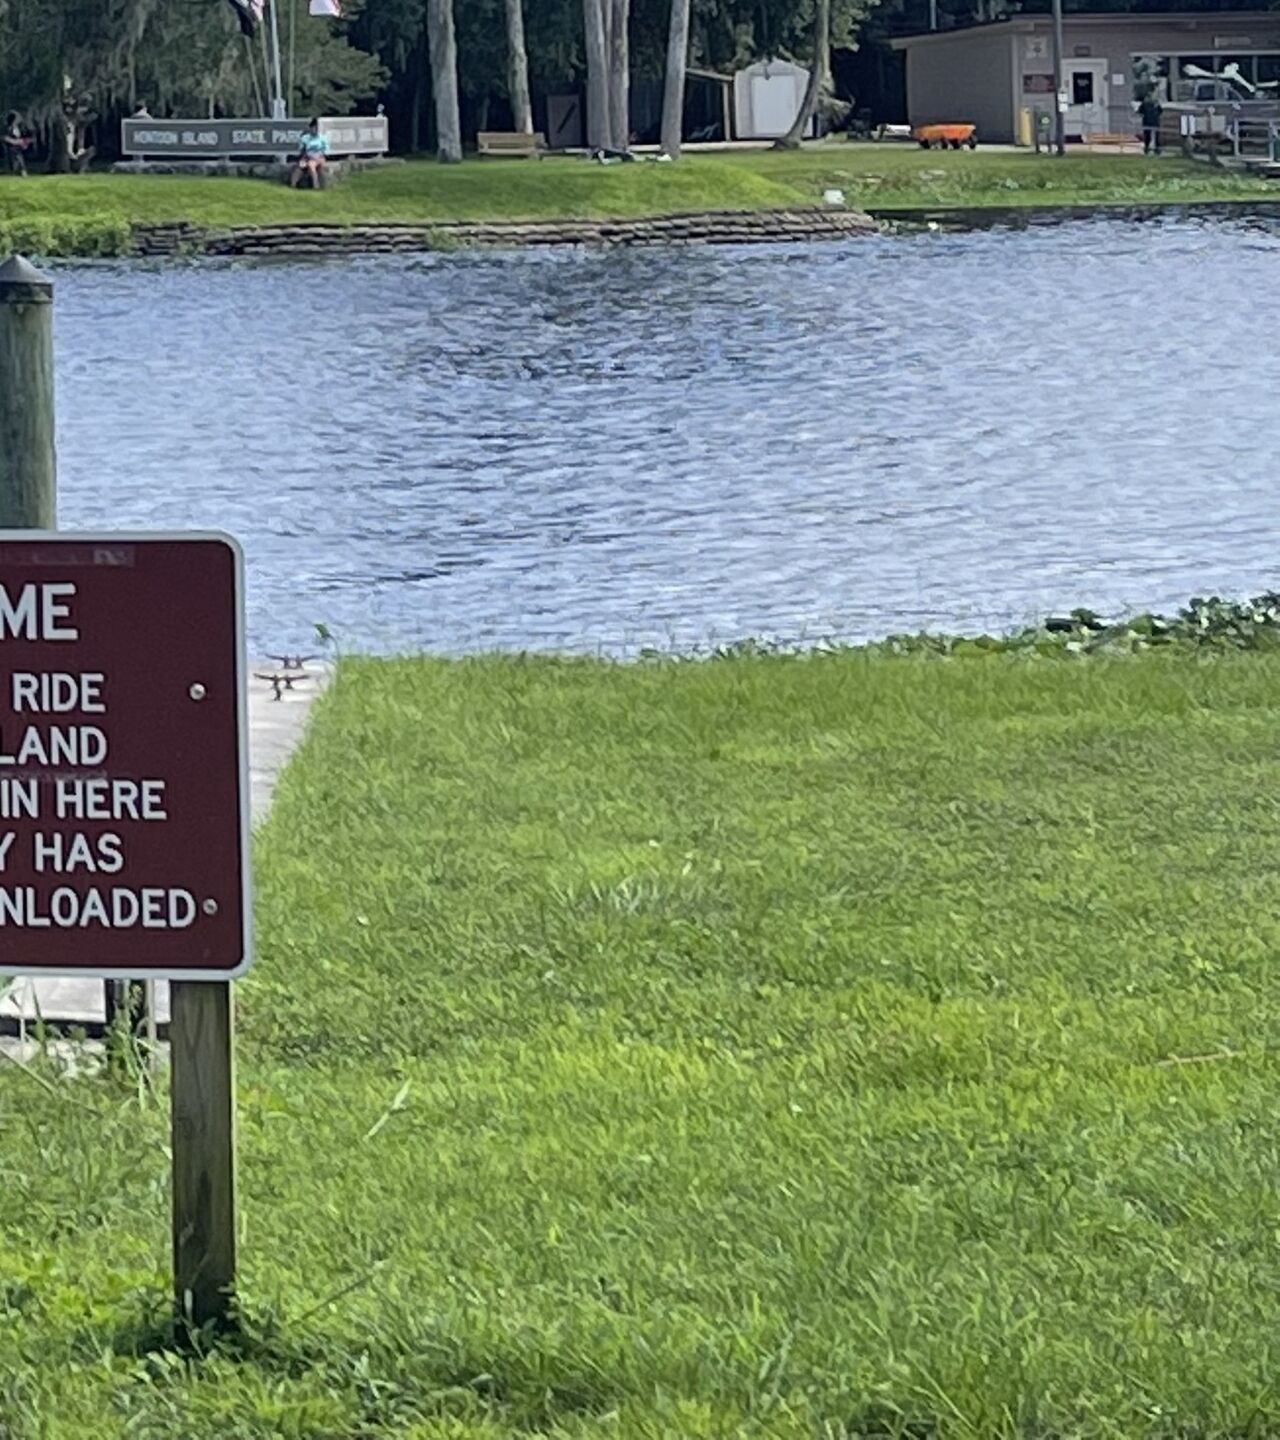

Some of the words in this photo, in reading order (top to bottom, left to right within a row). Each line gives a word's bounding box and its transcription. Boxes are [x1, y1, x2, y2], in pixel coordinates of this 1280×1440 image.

[181, 130, 219, 146] ISLAND
[231, 128, 267, 144] STATE
[12, 673, 106, 713] RIDE
[56, 779, 168, 820] HERE
[35, 832, 124, 874] HAS
